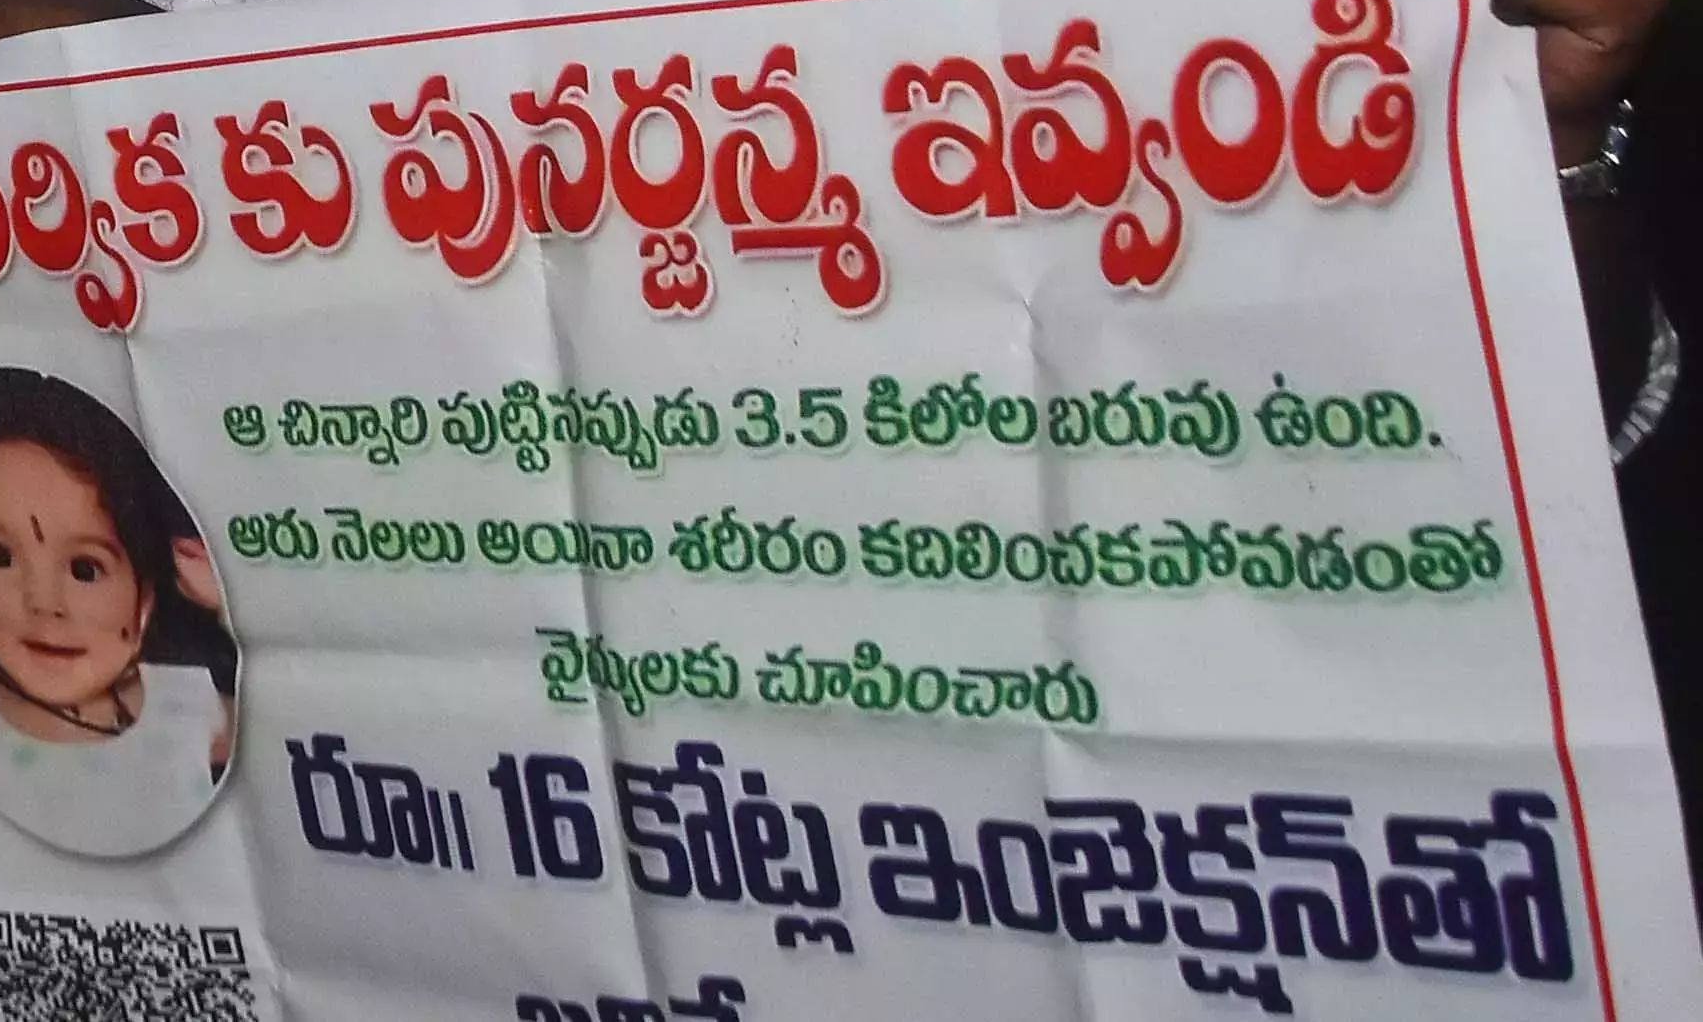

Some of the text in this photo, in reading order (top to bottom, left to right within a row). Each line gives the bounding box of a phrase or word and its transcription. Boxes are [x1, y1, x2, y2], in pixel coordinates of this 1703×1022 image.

[214, 99, 356, 258] కు
[368, 41, 884, 316] పునర్జన్మ
[277, 396, 429, 466] చిన్నారి
[436, 379, 720, 473] పుట్టినప్పుడు
[731, 388, 849, 449] 3.5
[862, 373, 1039, 448] కిలోల
[1046, 381, 1242, 458] బరువు
[1252, 373, 1443, 449] ఉంది.
[323, 506, 467, 565] నెలలు
[476, 516, 655, 572] అయినా
[667, 505, 847, 577] శరీరం
[857, 518, 1504, 594] కదిలించకపోవడంతో
[534, 625, 1100, 726] వైద్యులకు చూపించారు
[486, 751, 605, 882] 16
[611, 740, 856, 956] కోట్ల
